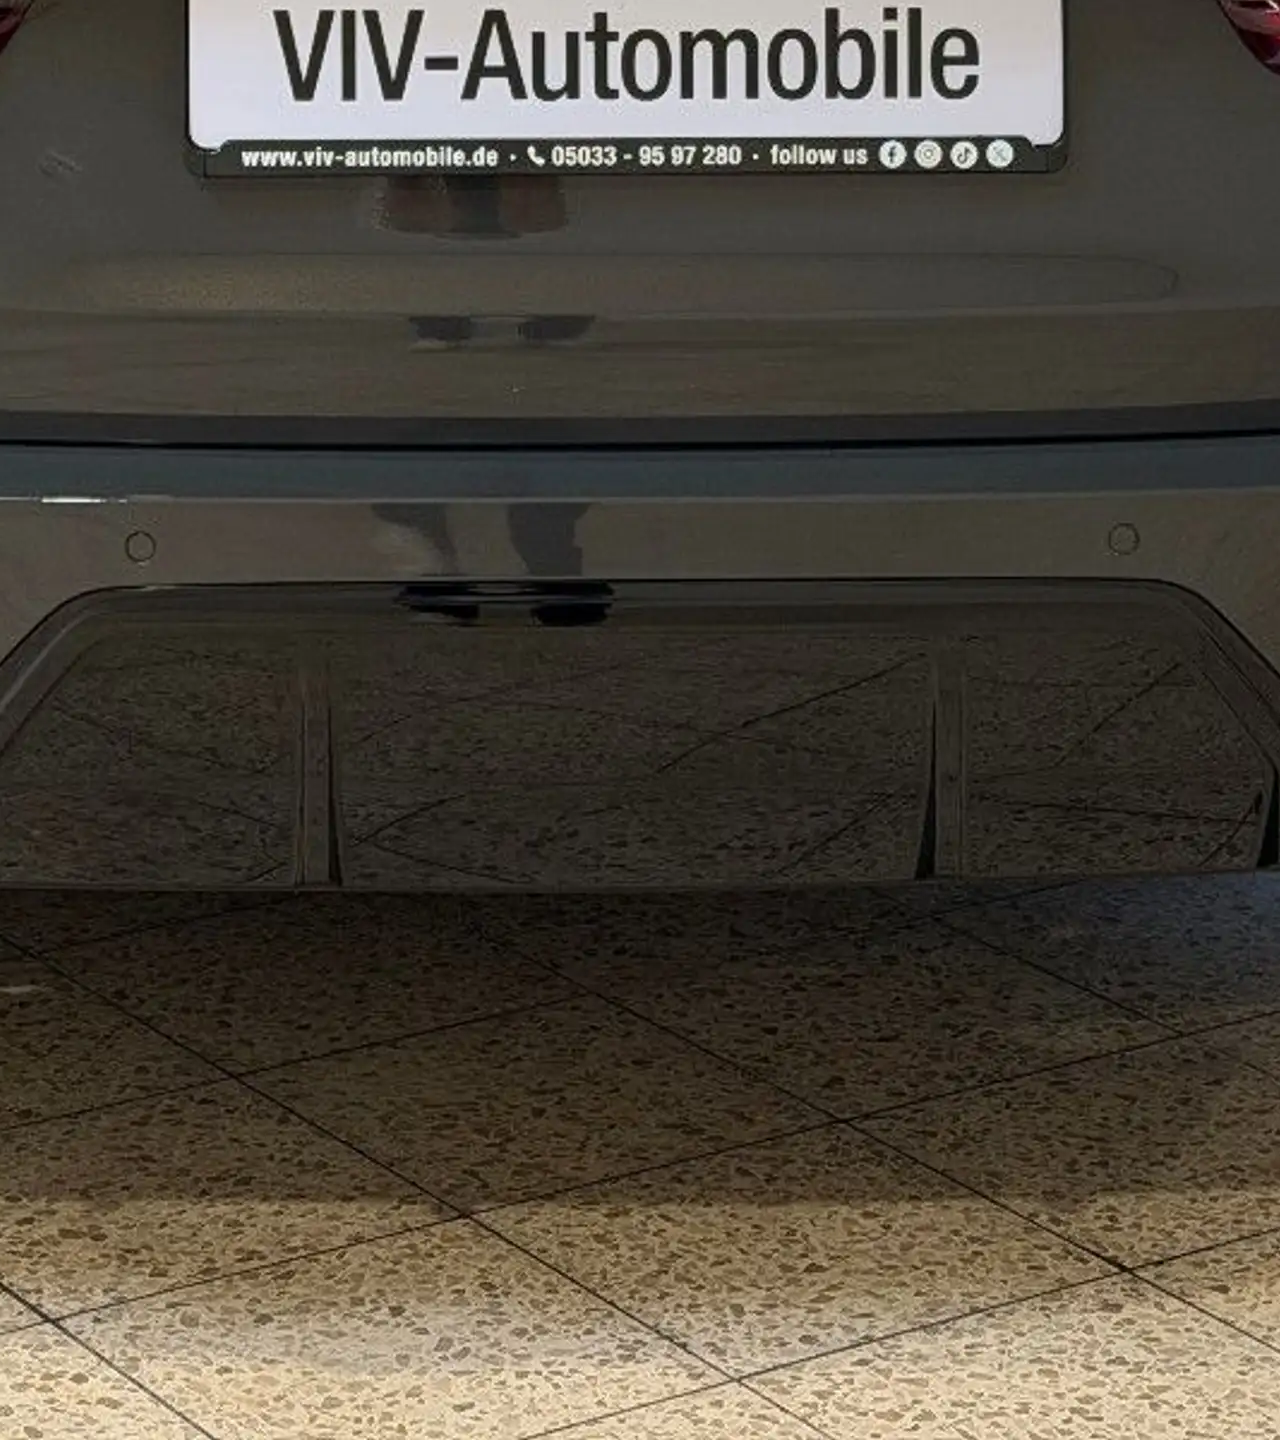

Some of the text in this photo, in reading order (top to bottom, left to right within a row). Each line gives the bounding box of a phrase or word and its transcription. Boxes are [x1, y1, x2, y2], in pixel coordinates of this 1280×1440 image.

[273, 7, 980, 102] VIV-Automobile
[241, 145, 498, 167] www.viv-automobile.de
[551, 145, 618, 167] 05033
[639, 145, 665, 167] 95
[670, 144, 697, 166] 97
[702, 144, 742, 165] 280
[769, 143, 838, 165] follow
[843, 148, 869, 165] us
